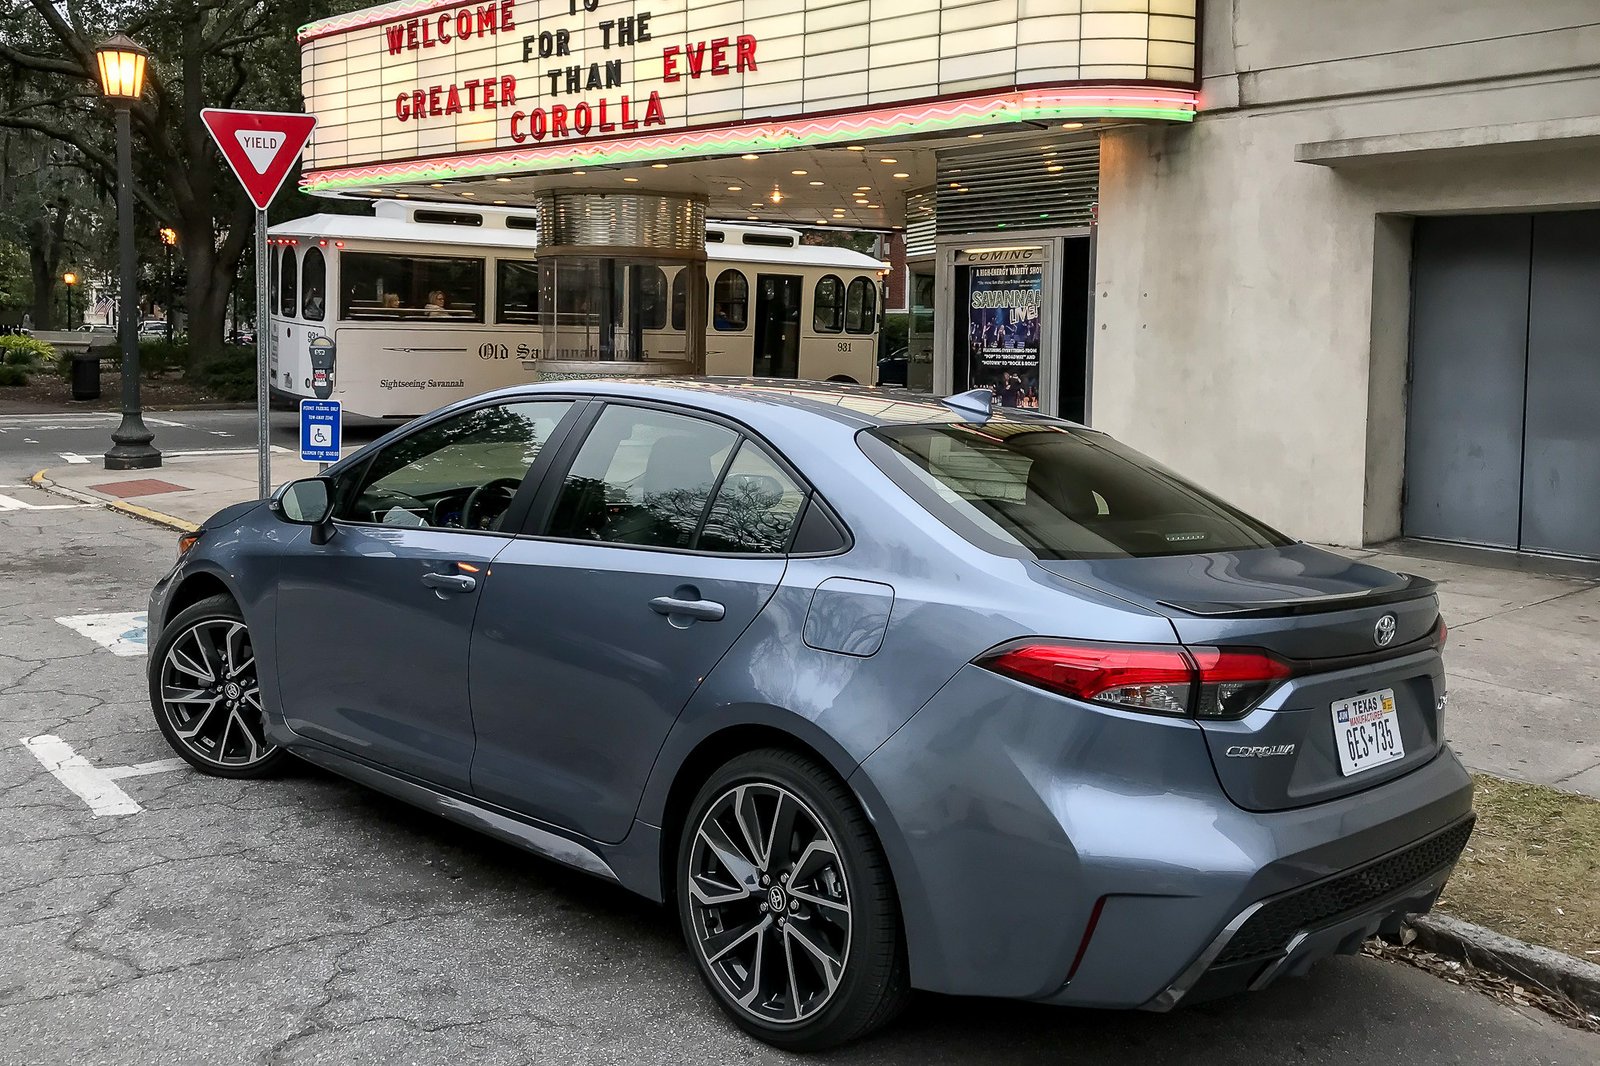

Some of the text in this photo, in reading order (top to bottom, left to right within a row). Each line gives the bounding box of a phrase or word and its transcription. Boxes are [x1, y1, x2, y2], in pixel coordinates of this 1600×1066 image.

[386, 1, 515, 55] WELCOME
[522, 12, 652, 62] FOR THE
[396, 34, 757, 121] GREATER THAN EVER
[511, 91, 666, 143] COROLLA
[243, 136, 277, 149] YIELD
[968, 250, 1033, 261] COMING
[1010, 267, 1028, 275] VARIETY
[478, 342, 509, 360] Old
[837, 342, 851, 352] 931
[380, 379, 464, 390] Sightseeing Savannah
[1353, 697, 1377, 715] TEXAS
[1226, 744, 1295, 757] COROLLA
